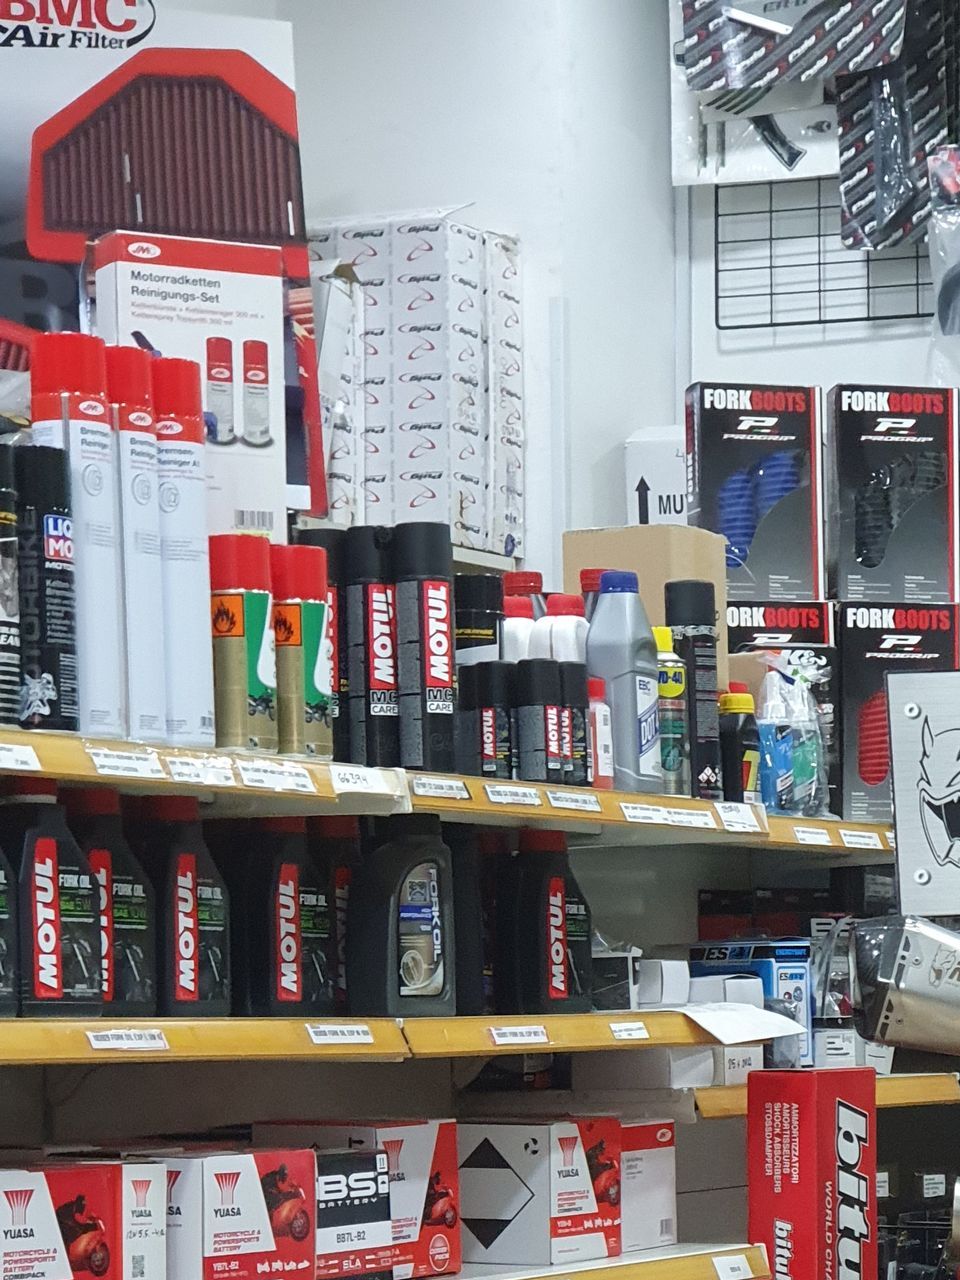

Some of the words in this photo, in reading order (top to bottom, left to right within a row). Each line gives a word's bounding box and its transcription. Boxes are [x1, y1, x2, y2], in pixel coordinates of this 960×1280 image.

[0, 24, 65, 48] Air
[68, 30, 125, 49] Filter
[131, 271, 221, 288] Motorradketten
[131, 286, 220, 304] Reinigungs-Set
[704, 389, 806, 412] FORKBOOTS
[841, 391, 944, 414] FORKBOOTS
[659, 494, 687, 515] MU
[49, 518, 73, 536] LIQ
[49, 540, 74, 557] MO
[727, 606, 820, 629] ORKBOOTS
[847, 607, 951, 631] FORKBOOTS
[373, 589, 394, 684] MOTUL
[428, 586, 449, 682] MOTUL
[372, 706, 398, 714] CARE
[428, 702, 453, 712] CARE
[483, 710, 494, 756] MOTUL
[547, 707, 559, 754] MOTUL
[641, 720, 656, 745] DOT
[59, 874, 78, 887] FORK
[79, 875, 92, 888] OIL
[113, 883, 132, 896] FORK
[133, 884, 146, 897] OIL
[197, 886, 212, 898] FORK
[428, 868, 441, 926] FORK
[35, 858, 57, 989] MOTUL
[177, 871, 195, 992] MOTUL
[279, 880, 297, 993] MOTUL
[433, 929, 443, 962] OIL
[549, 892, 565, 991] MOTUL
[765, 1102, 773, 1176] STOSSDAMPFER
[791, 1103, 799, 1183] AMMORTIZZATORI
[774, 1134, 782, 1193] ABSORBERS
[319, 1172, 376, 1200] BS
[214, 1207, 242, 1218] YUASA
[319, 1197, 377, 1208] BATTERY
[825, 1181, 833, 1244] WORLD
[3, 1228, 35, 1240] YUASA
[3, 1265, 34, 1274] BATTERY
[3, 1272, 46, 1280] COMBIPACK
